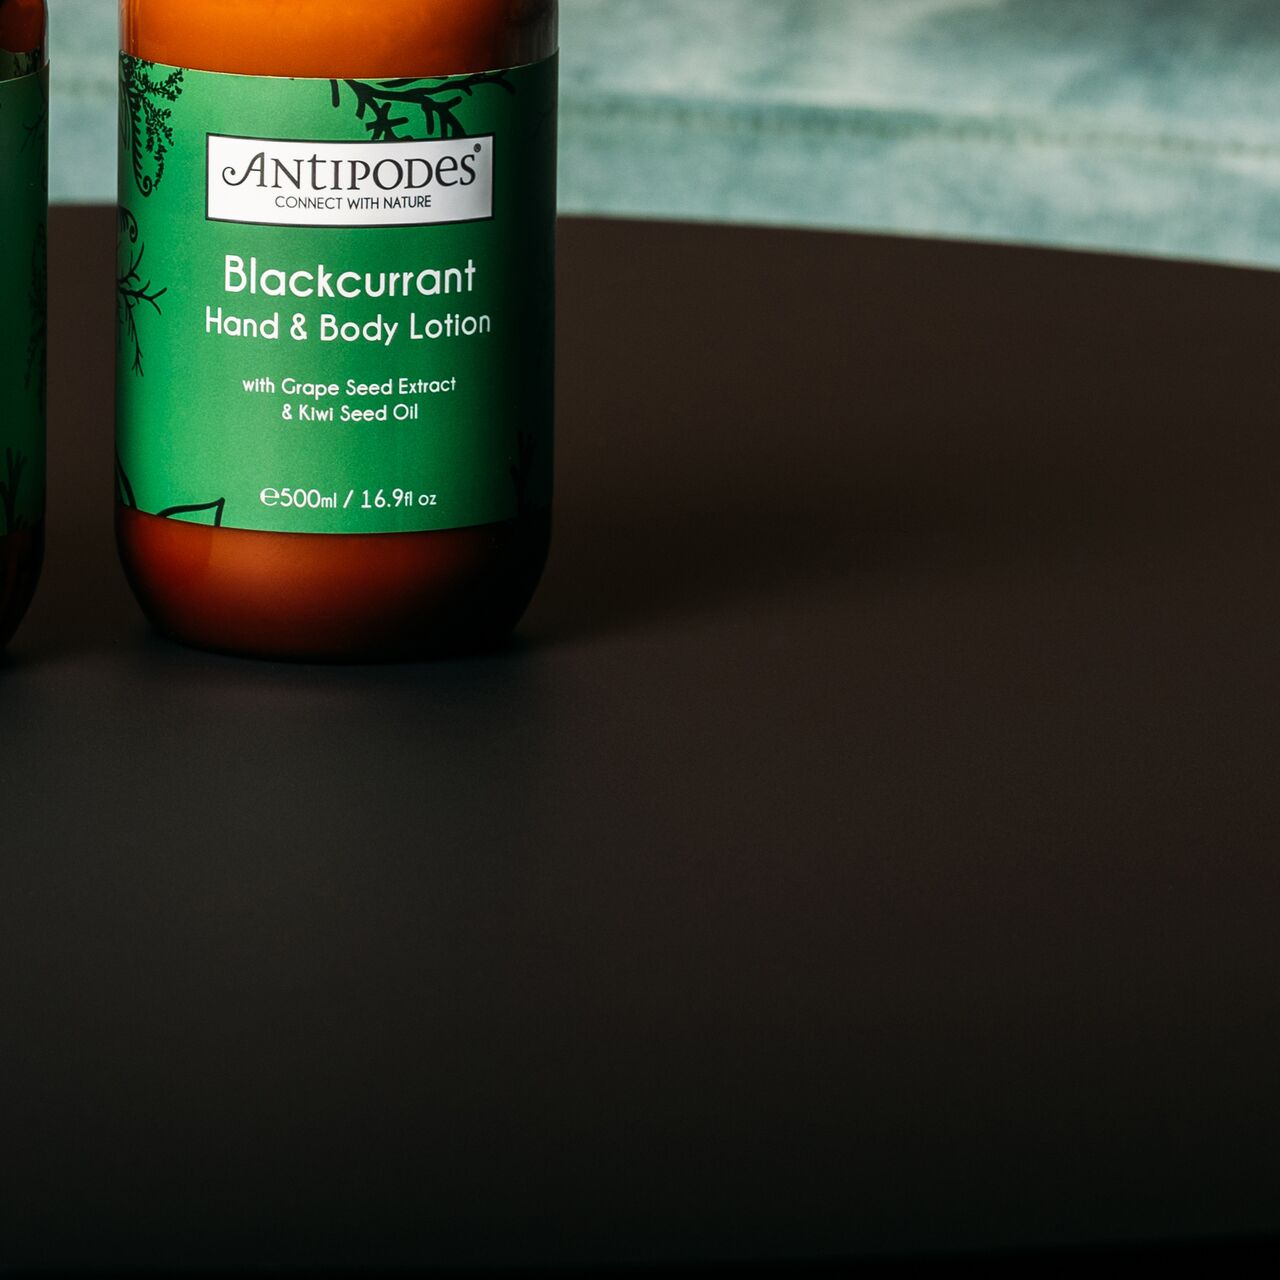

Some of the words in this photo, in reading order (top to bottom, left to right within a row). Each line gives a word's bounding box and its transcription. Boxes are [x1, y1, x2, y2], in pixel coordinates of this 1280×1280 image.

[274, 195, 344, 210] CONNECT
[346, 196, 380, 210] WITH
[383, 194, 432, 210] NATURE
[224, 254, 476, 299] Blackcurrant
[205, 305, 279, 340] Hand
[289, 312, 308, 341] &
[319, 313, 399, 346] Body
[410, 312, 490, 340] Lotion
[242, 376, 275, 394] with
[281, 377, 340, 401] Grape
[345, 378, 393, 396] Seed
[398, 376, 457, 395] Extract
[281, 403, 293, 421] &
[298, 404, 334, 422] Kiwi
[339, 404, 387, 422] Seed
[392, 403, 418, 421] Oil
[418, 494, 437, 506] oz
